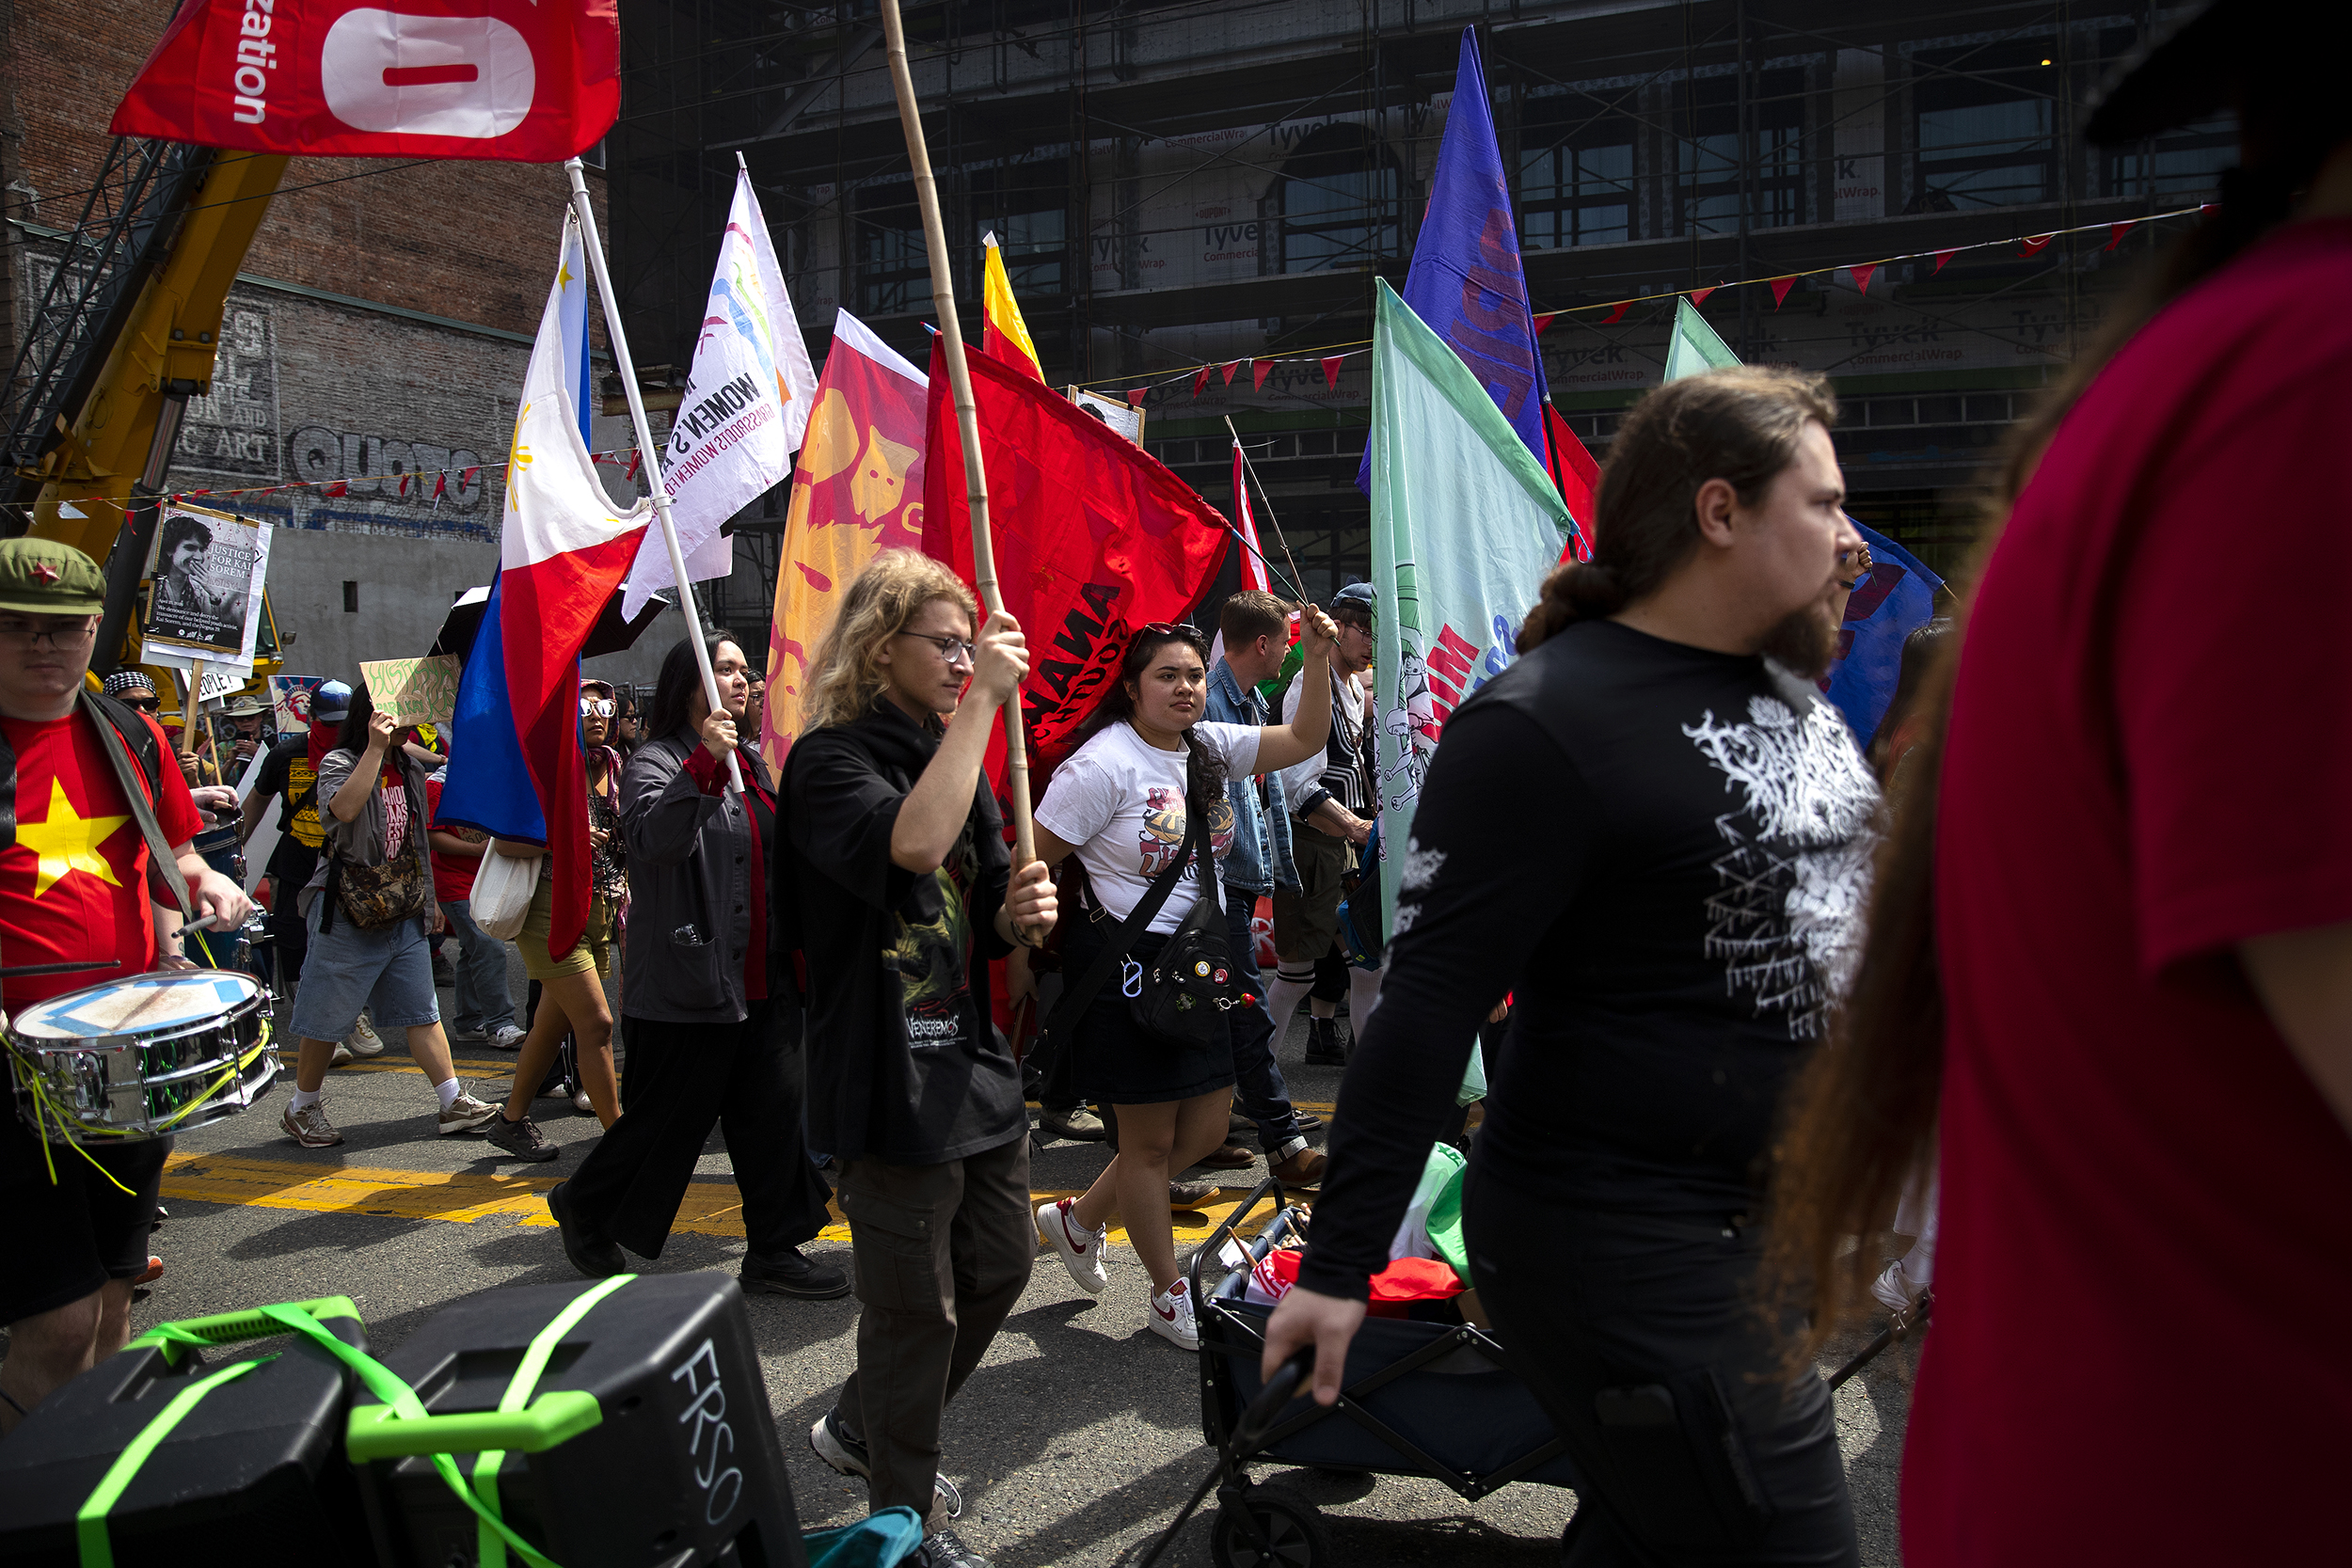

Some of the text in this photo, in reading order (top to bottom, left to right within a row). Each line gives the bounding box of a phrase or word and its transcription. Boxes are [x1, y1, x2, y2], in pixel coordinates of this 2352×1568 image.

[232, 0, 278, 124] zation
[322, 8, 536, 139] O
[1165, 129, 1246, 149] CommercialWra
[1204, 222, 1259, 251] Tyve
[1203, 247, 1259, 262] Commercia
[214, 426, 269, 462] ART
[208, 544, 251, 562] JUSTICE
[211, 553, 252, 571] FOR KAI
[208, 562, 246, 578] SOREM
[669, 1337, 743, 1527] FRSO
